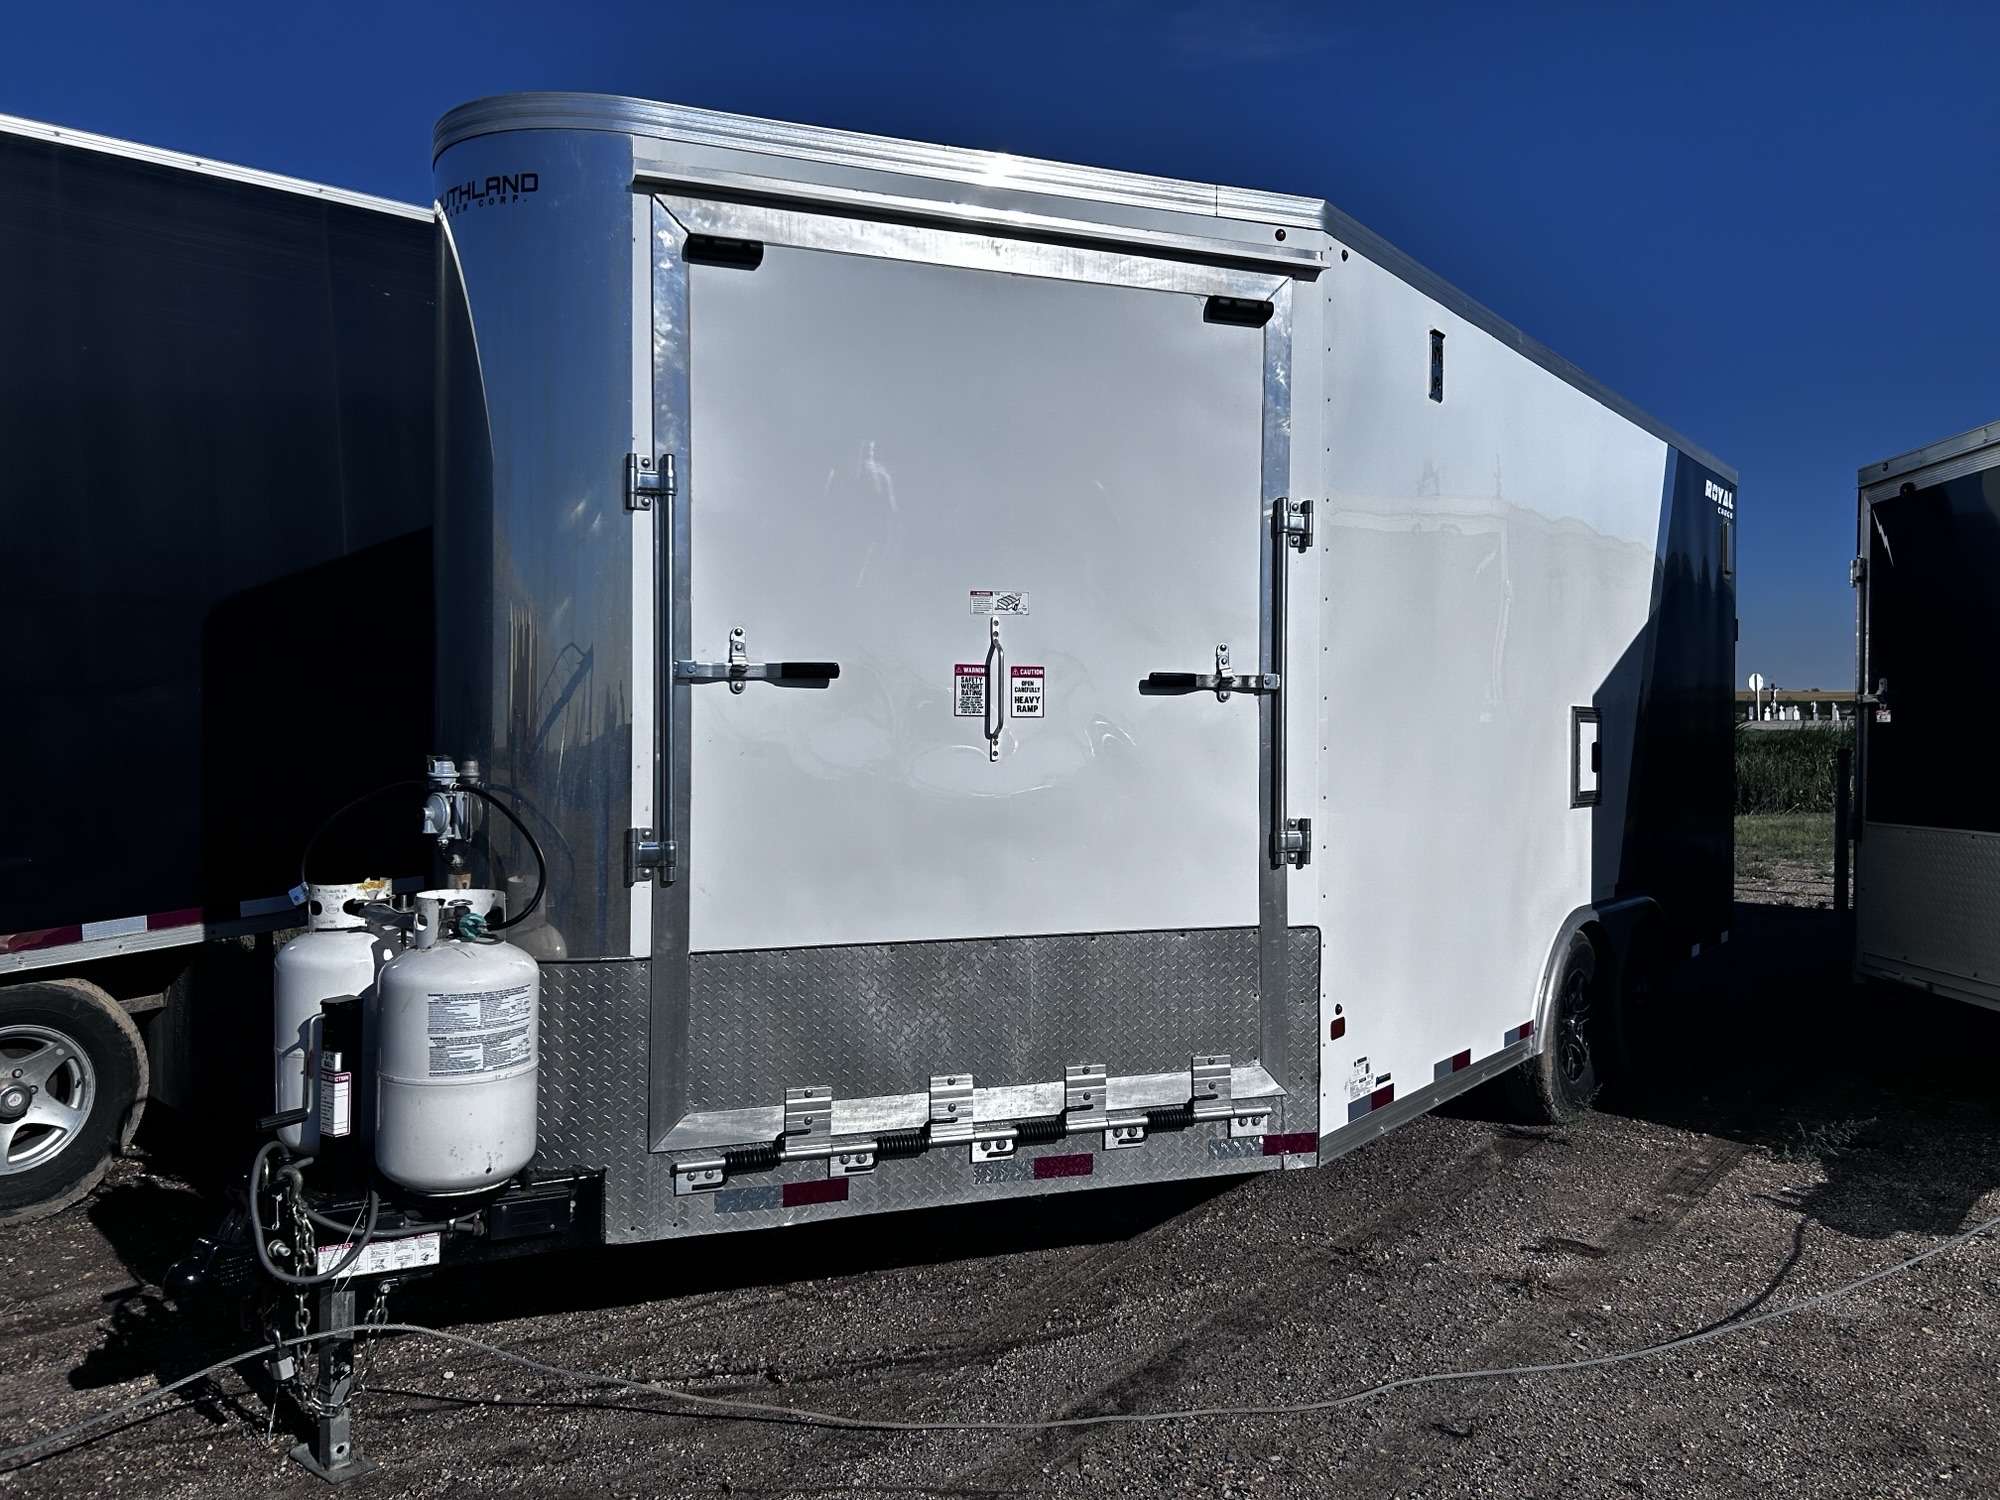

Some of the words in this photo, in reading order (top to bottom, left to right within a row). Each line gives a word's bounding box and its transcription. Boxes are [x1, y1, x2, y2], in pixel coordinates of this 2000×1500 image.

[440, 173, 538, 210] UTHLAND
[1705, 479, 1734, 510] ROYAL
[1019, 668, 1044, 676] CAUTION
[1014, 696, 1041, 704] HEAVY
[1016, 705, 1039, 713] RAMP
